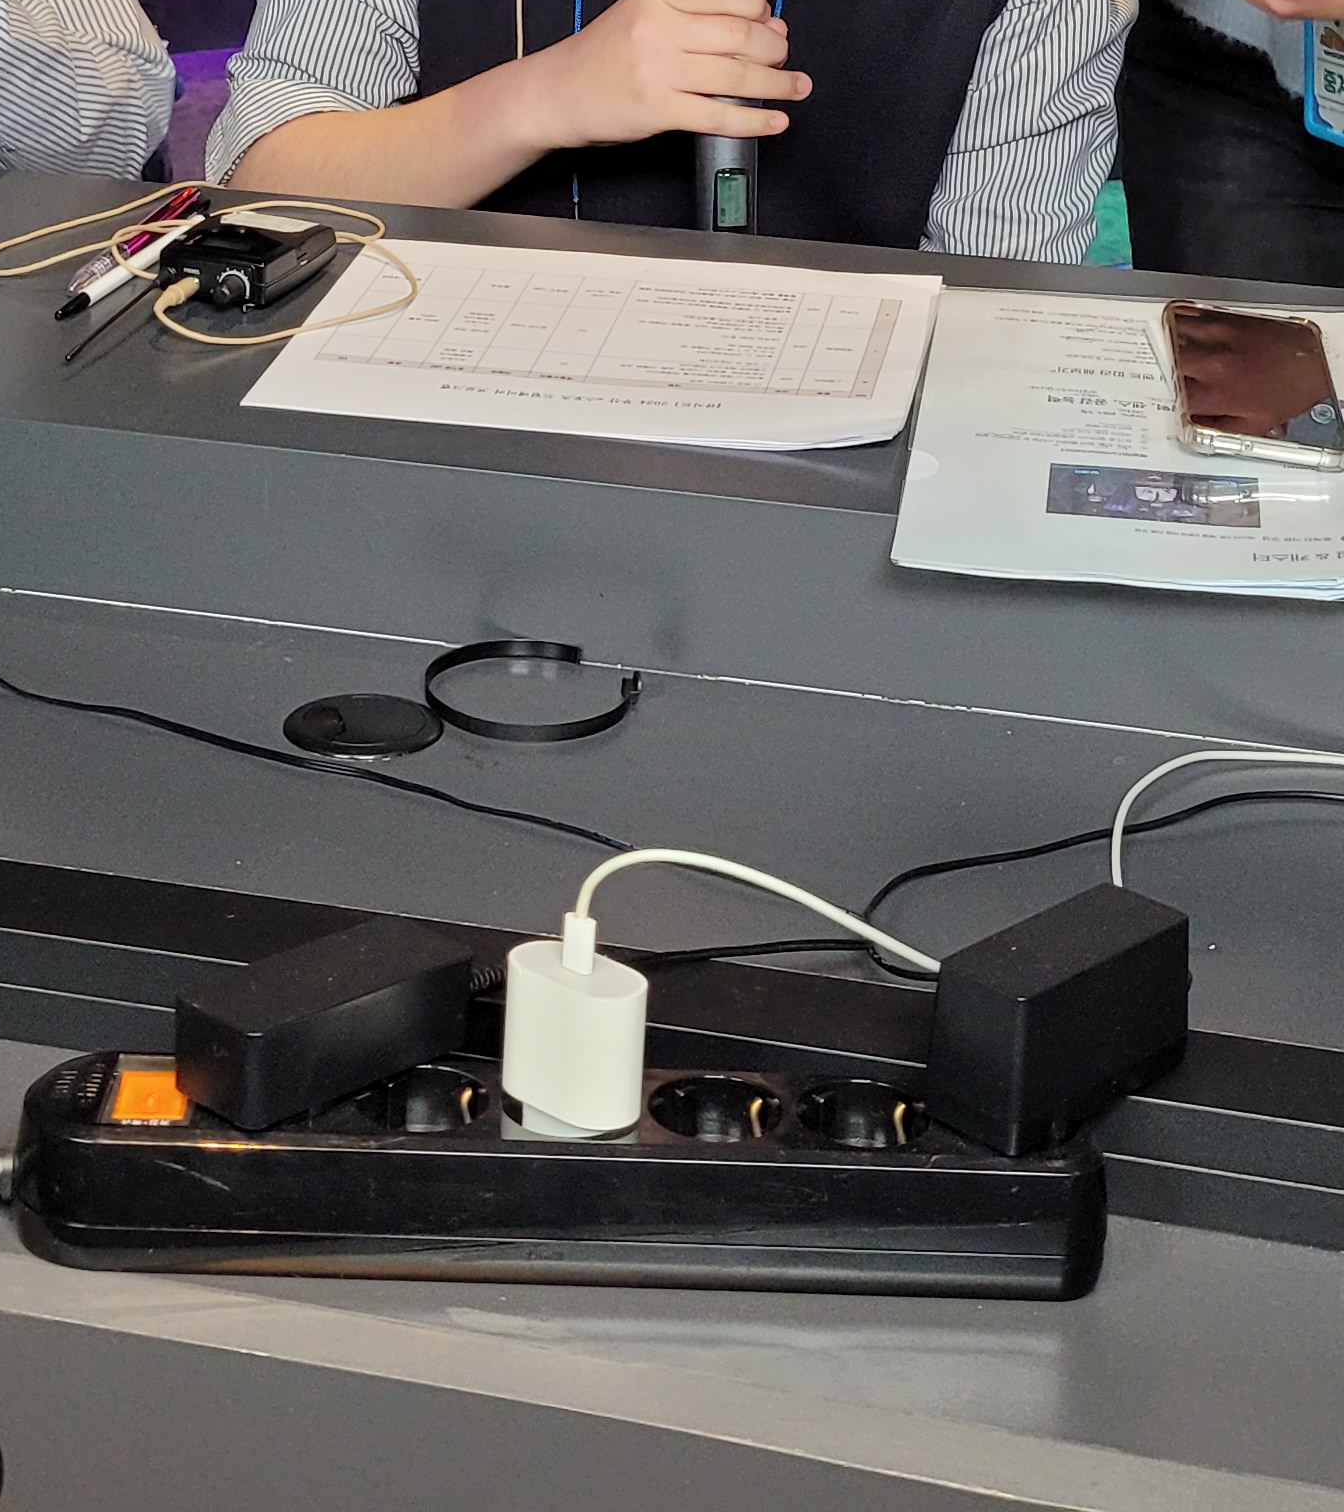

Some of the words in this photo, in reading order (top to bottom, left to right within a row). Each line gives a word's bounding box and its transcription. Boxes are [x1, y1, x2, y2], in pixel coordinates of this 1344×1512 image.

[1080, 397, 1108, 406] 공감
[1251, 552, 1310, 563] 캐스터
[1314, 552, 1330, 560] &
